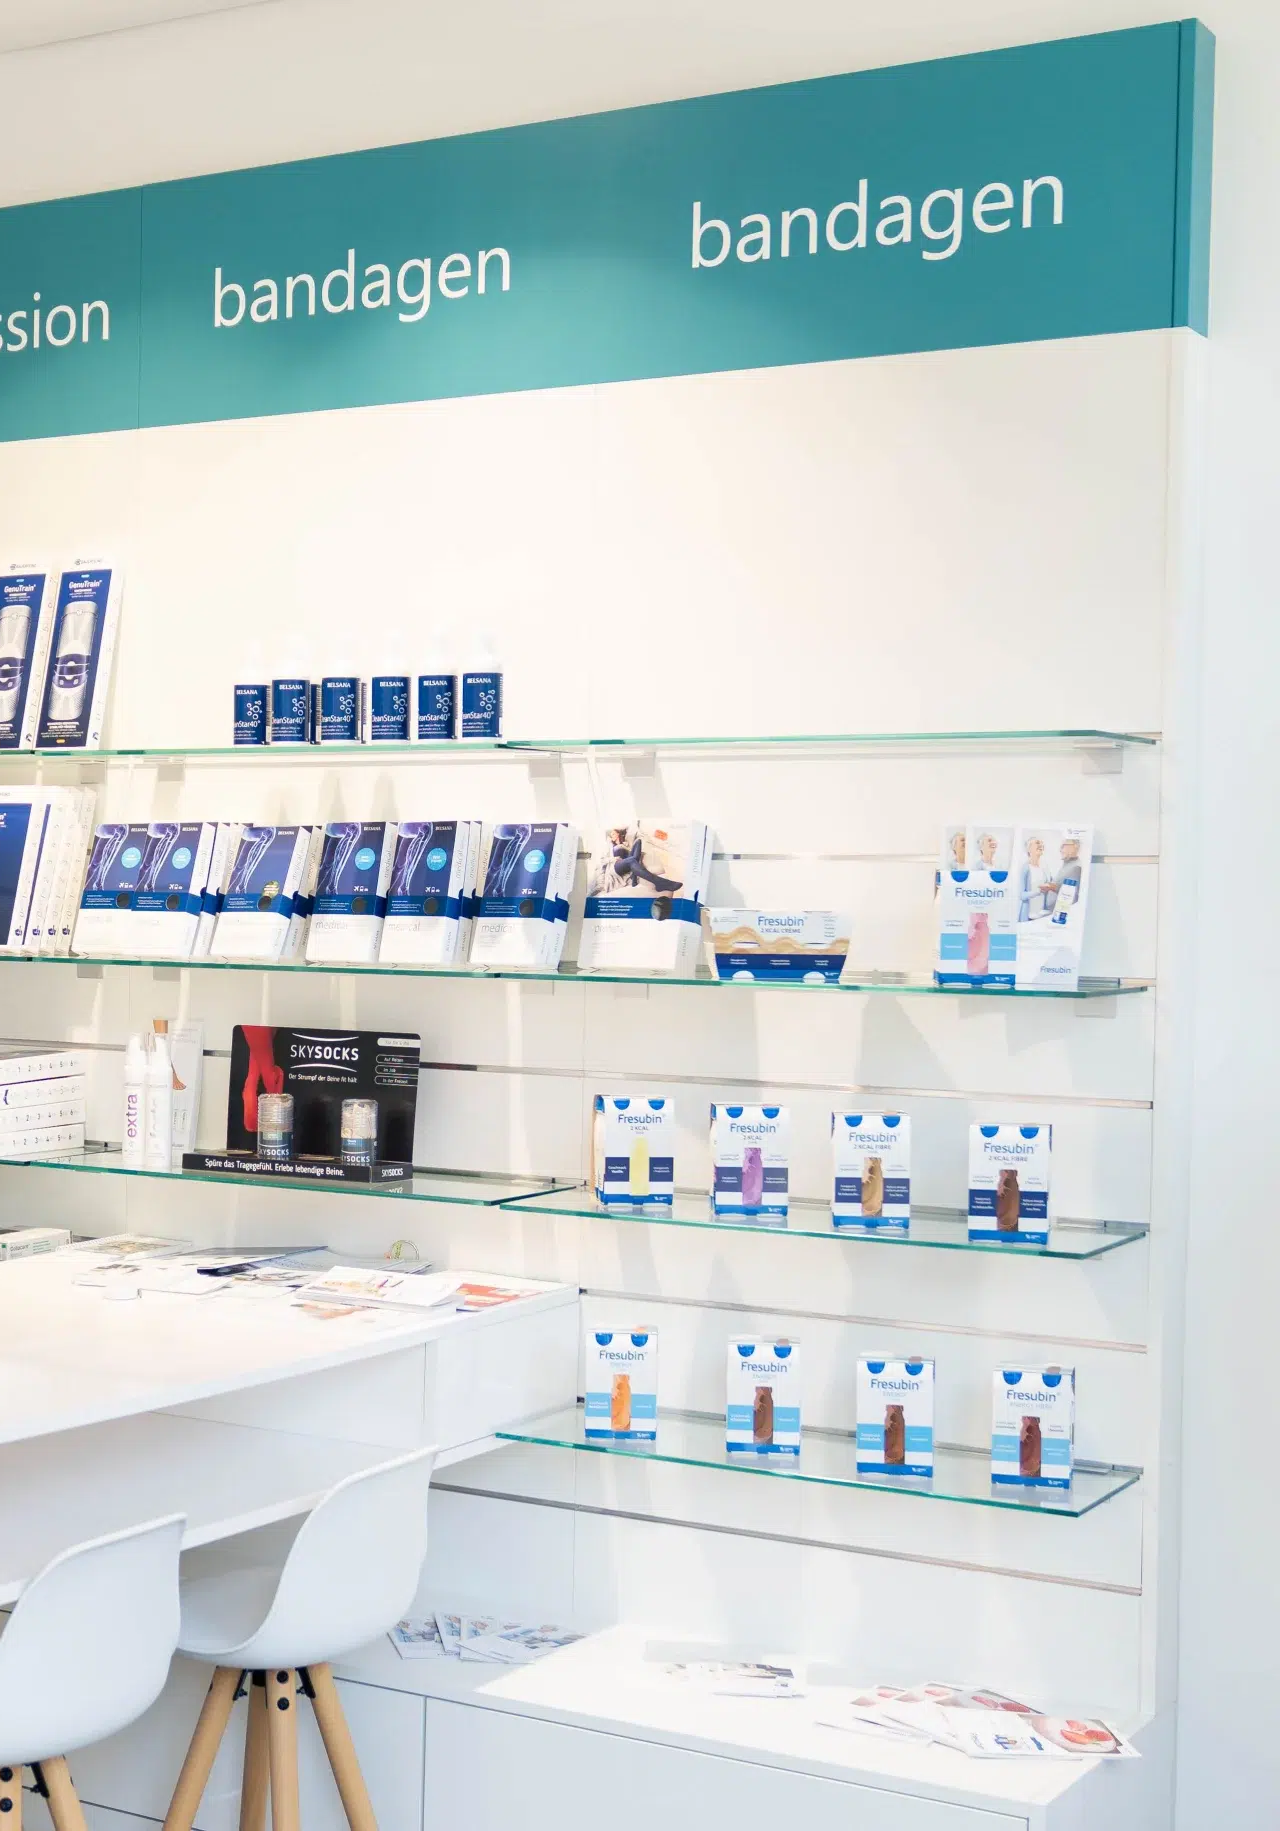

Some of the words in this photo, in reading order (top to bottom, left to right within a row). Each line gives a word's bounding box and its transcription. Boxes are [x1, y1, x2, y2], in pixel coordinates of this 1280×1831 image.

[690, 174, 1064, 269] bandagen
[213, 246, 512, 327] bandagen
[954, 887, 1004, 898] Fresubin
[757, 916, 805, 927] Fresubin
[1040, 966, 1072, 974] Fresubin
[290, 1044, 359, 1060] SKYSOCKS
[298, 1074, 317, 1082] Strumpf
[126, 1094, 138, 1138] extra
[617, 1113, 662, 1123] Fresubin
[730, 1123, 776, 1133] Fresubin
[848, 1132, 897, 1142] Fresubin
[983, 1142, 1034, 1154] Fresubin
[205, 1158, 222, 1168] Spüre
[224, 1160, 235, 1169] das
[275, 1163, 294, 1173] Erlebe
[295, 1165, 324, 1176] lebendige
[325, 1167, 345, 1177] Beine.
[381, 1168, 404, 1178] SKYSOCKS
[599, 1350, 645, 1361] Fresubin
[741, 1361, 787, 1373] Fresubin
[870, 1379, 919, 1390] Fresubin
[1006, 1390, 1057, 1402] Fresubin
